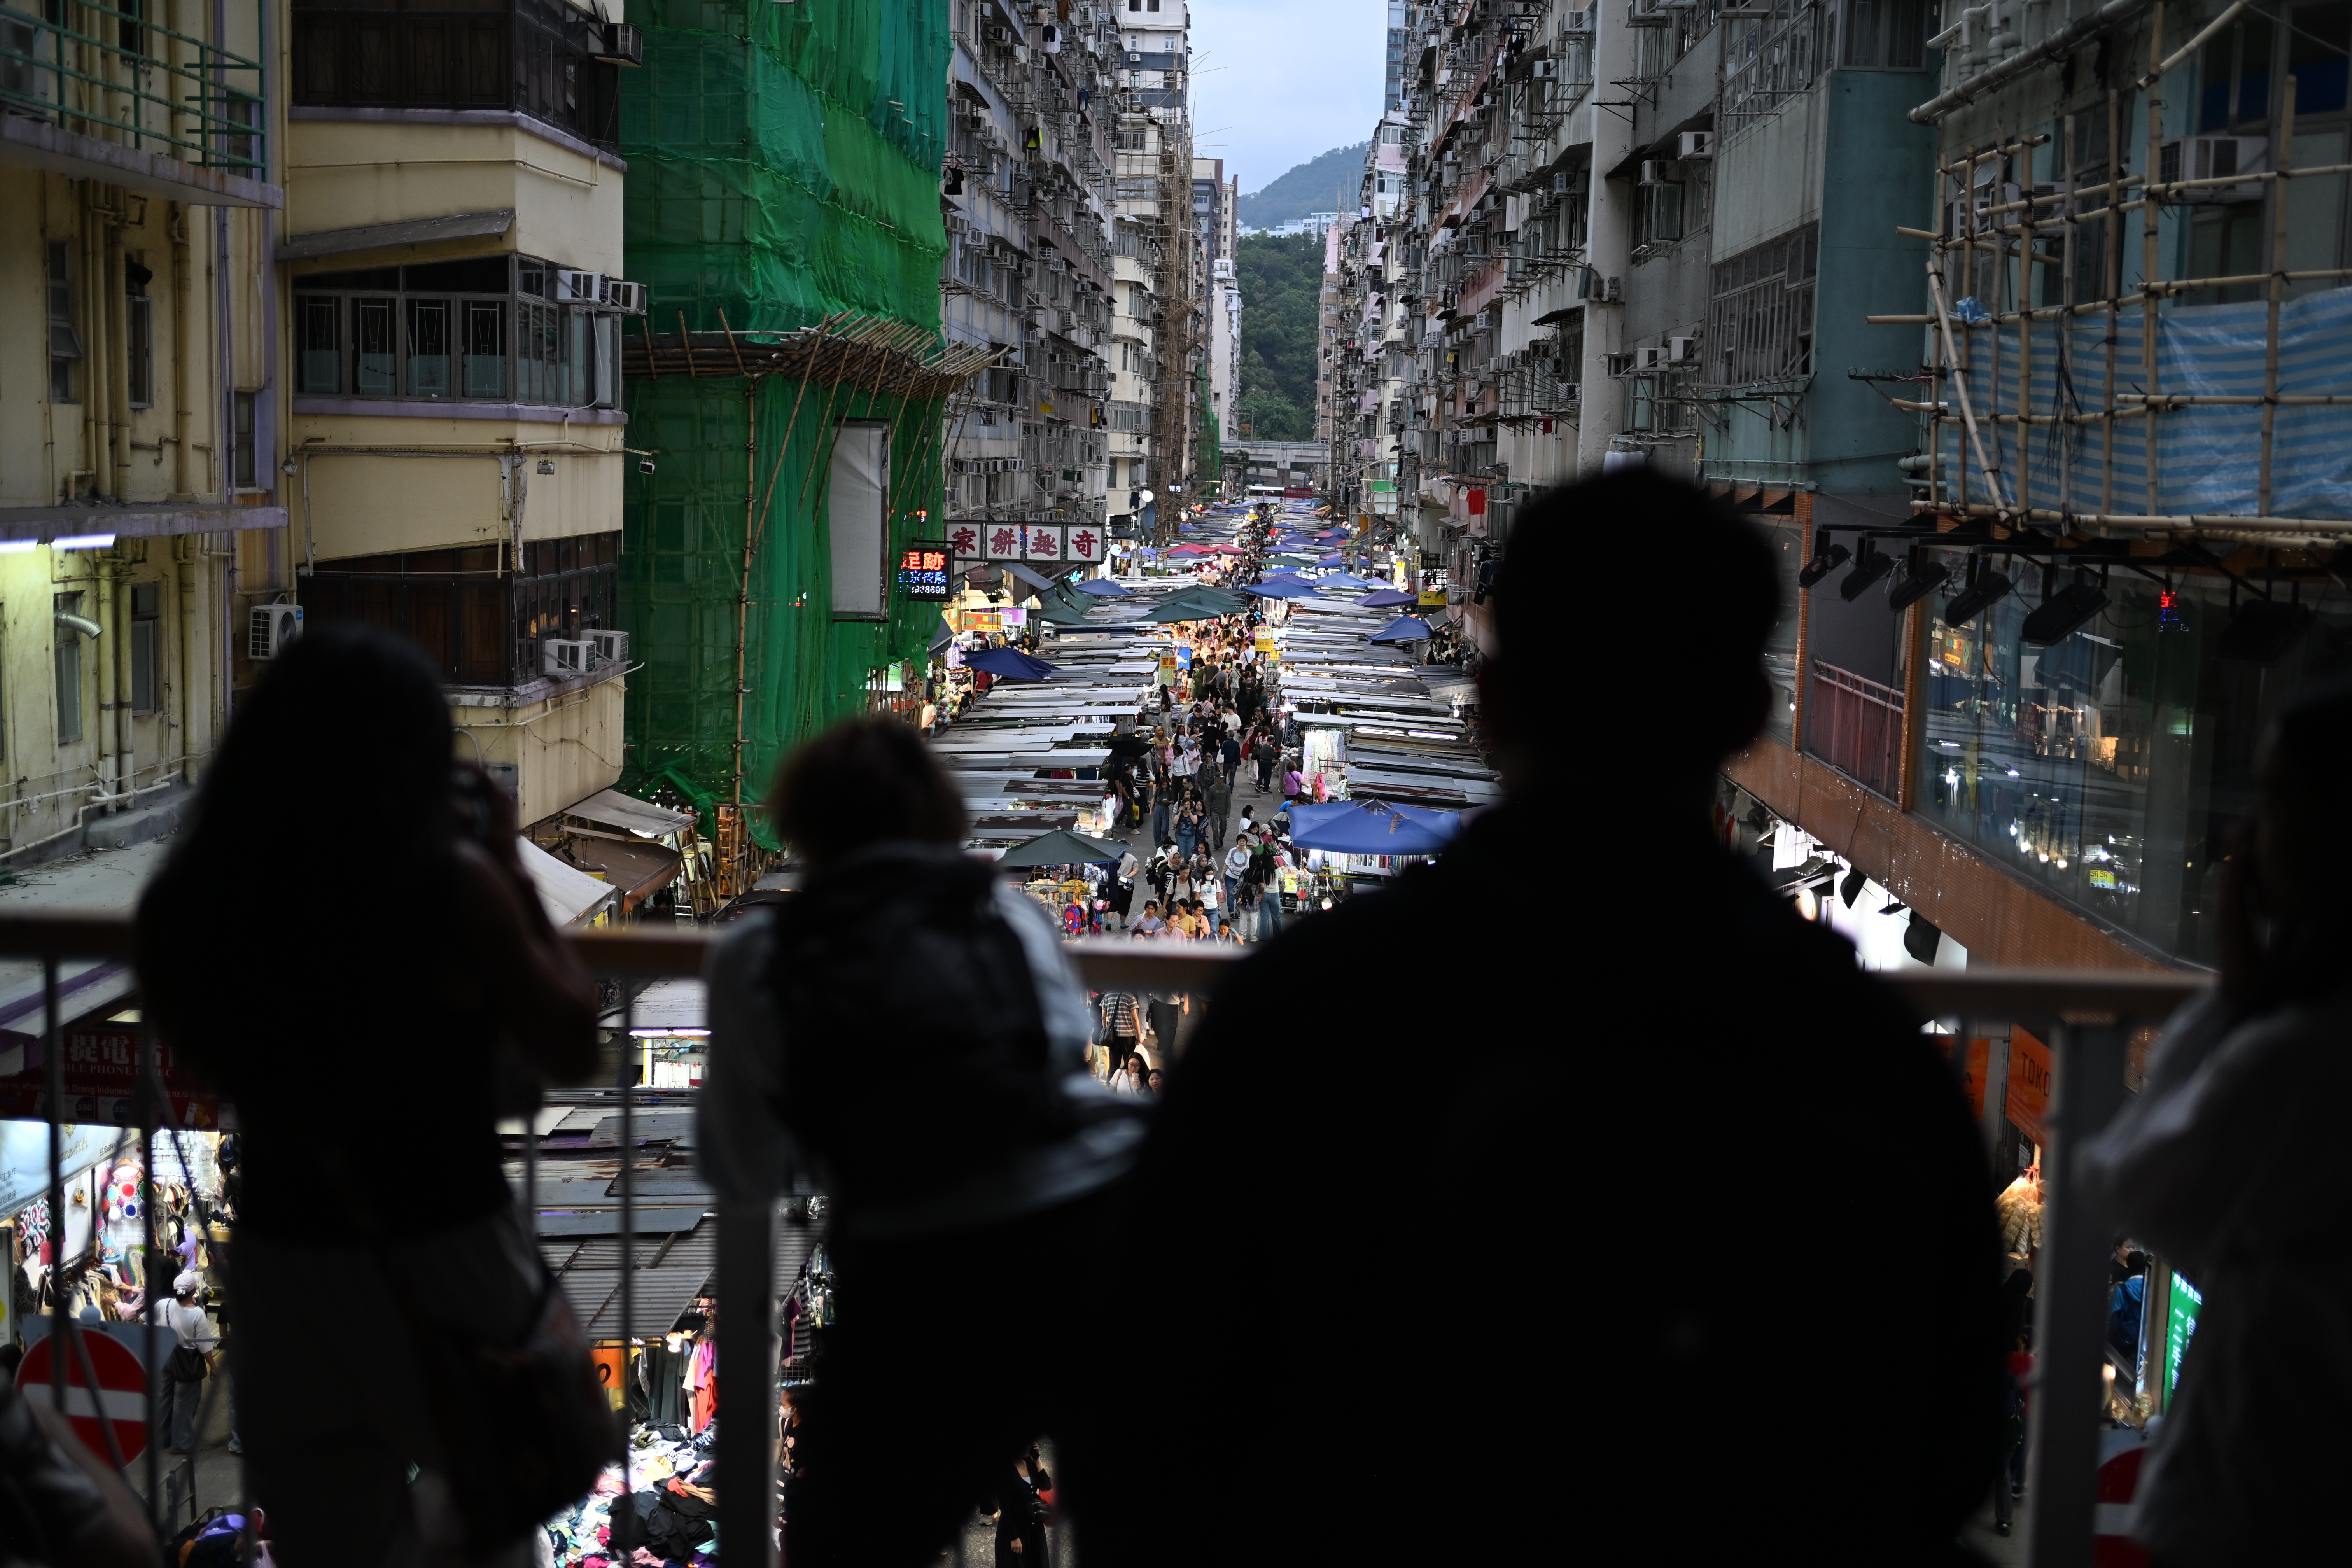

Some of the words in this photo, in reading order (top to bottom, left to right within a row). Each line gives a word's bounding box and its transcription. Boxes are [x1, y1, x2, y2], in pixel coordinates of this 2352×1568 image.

[90, 1065, 131, 1075] PHONE
[2022, 1052, 2051, 1098] TOKO
[23, 1082, 48, 1092] khusu
[72, 1084, 95, 1095] Orang
[97, 1086, 135, 1096] Indonesia
[77, 1102, 92, 1112] $50
